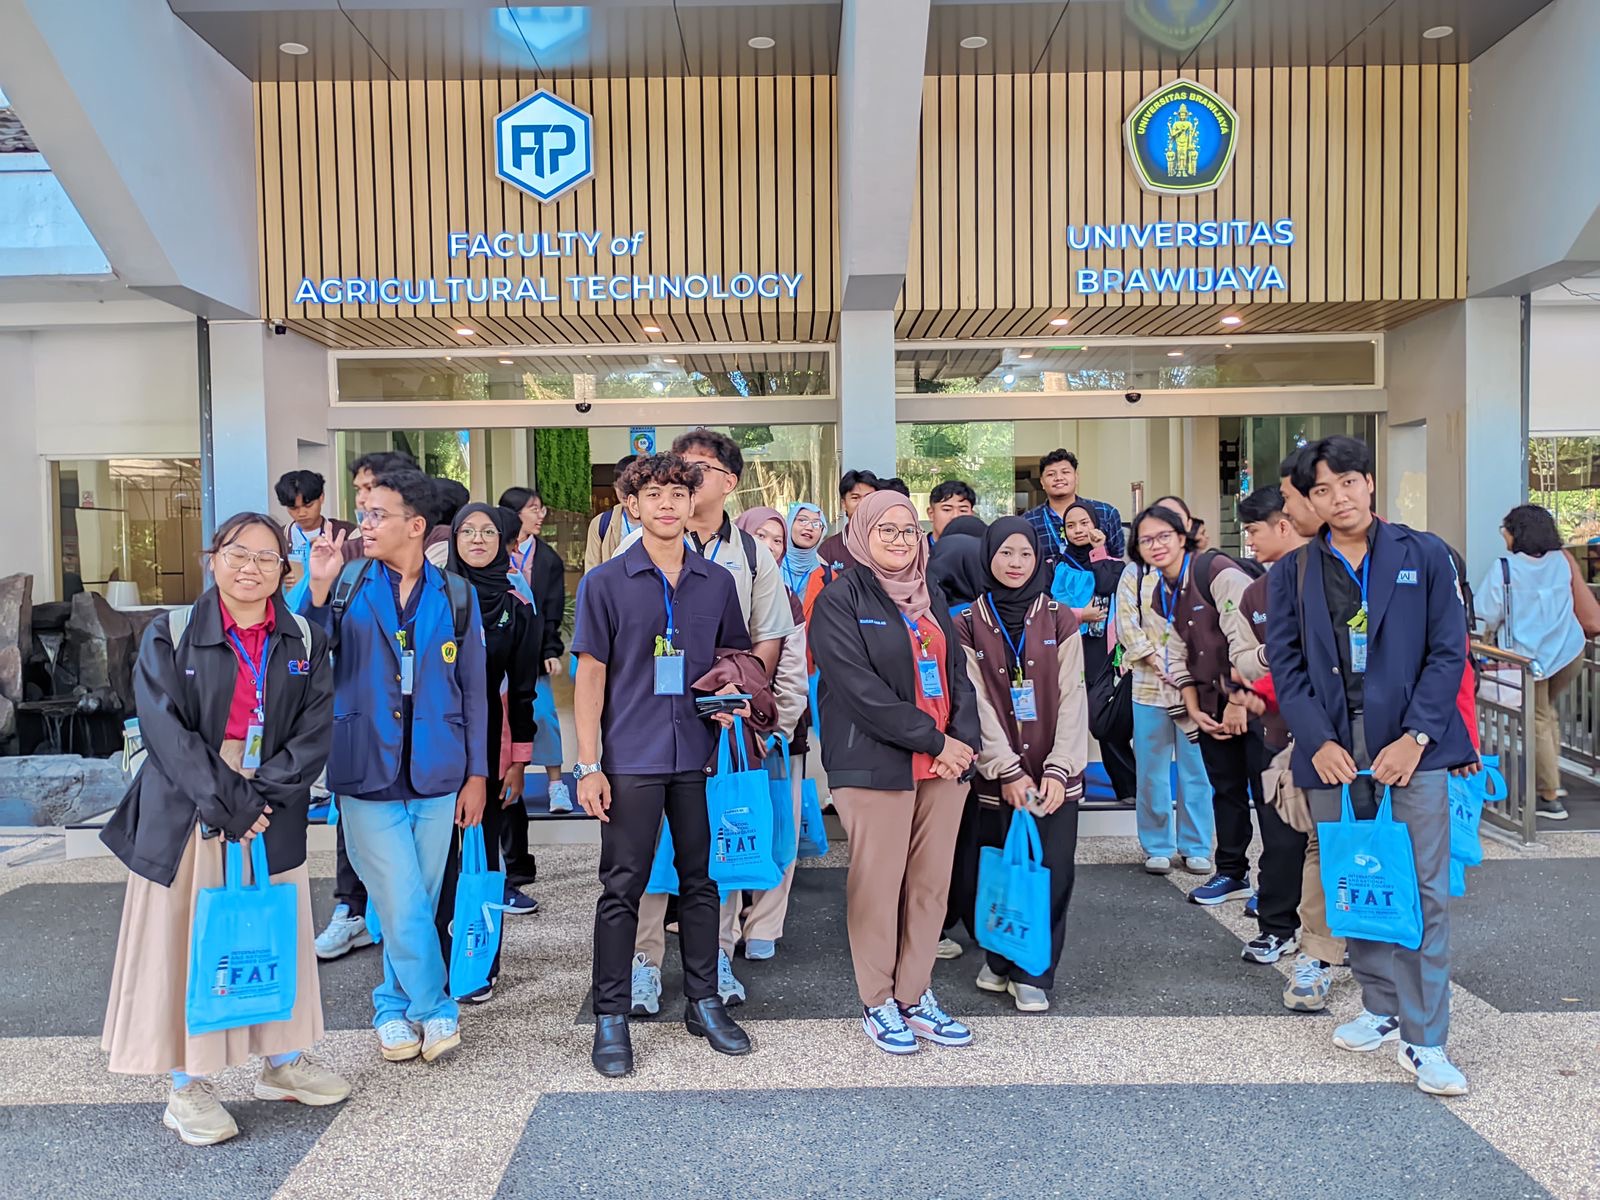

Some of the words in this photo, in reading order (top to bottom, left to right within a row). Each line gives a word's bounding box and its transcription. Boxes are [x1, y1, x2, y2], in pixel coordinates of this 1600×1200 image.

[1137, 92, 1187, 135] UNIVERSITAS
[1189, 92, 1229, 135] BRAWIJAYA
[449, 231, 601, 258] FACULTY
[610, 230, 645, 257] of
[1067, 219, 1295, 250] UNIVERSITAS
[294, 277, 559, 304] AGRICULTURAL
[565, 273, 803, 301] TECHNOLOGY
[1076, 264, 1286, 294] BRAWIJAYA
[725, 835, 757, 854] FAT
[1350, 889, 1394, 907] FAT
[994, 915, 1030, 940] FAT
[229, 962, 278, 985] FAT
